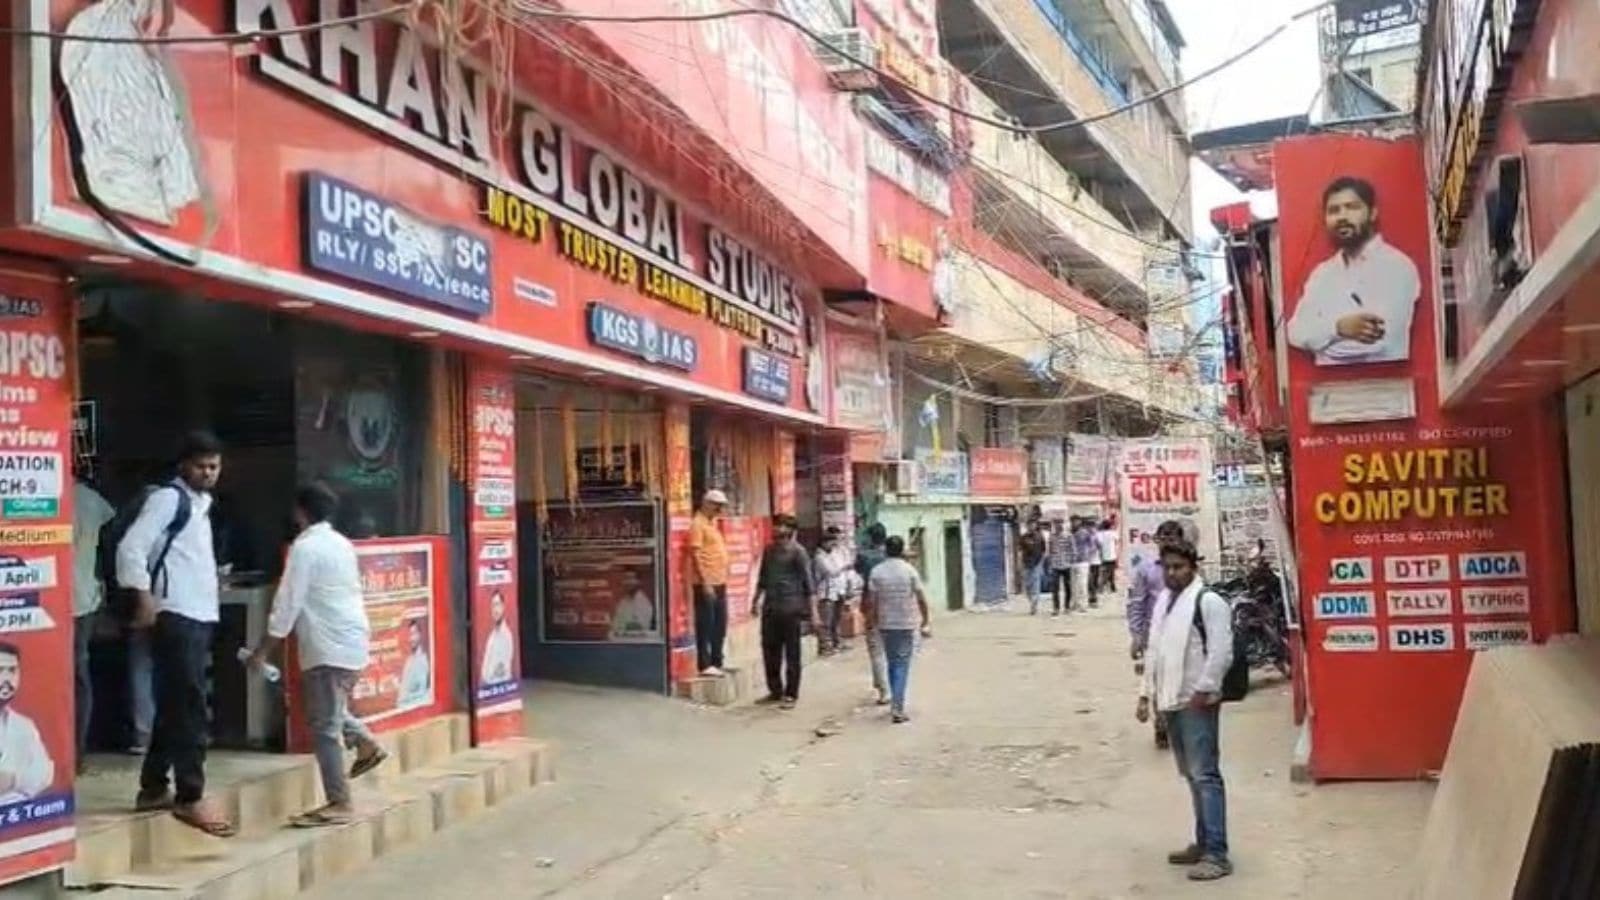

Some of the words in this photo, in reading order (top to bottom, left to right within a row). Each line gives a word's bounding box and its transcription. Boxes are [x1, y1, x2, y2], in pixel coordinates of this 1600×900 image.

[320, 181, 402, 246] UPSC
[520, 105, 698, 271] GLOBAL
[707, 224, 804, 328] STUDIES
[485, 186, 549, 243] MOST
[560, 221, 637, 284] TRUSTED
[643, 261, 707, 318] LEARNING
[601, 309, 638, 347] KGS
[663, 330, 695, 364] IAS
[1129, 464, 1200, 503] दारोगा
[1344, 448, 1488, 484] SAVITRI
[1315, 484, 1510, 524] COMPUTER
[5, 567, 40, 585] April
[1395, 559, 1441, 578] DTP
[1466, 555, 1521, 575] ADCA
[8, 612, 32, 626] PM
[1321, 597, 1368, 615] DDM
[1391, 595, 1446, 610] TALLY
[1396, 628, 1446, 646] DHS
[23, 799, 66, 818] Team
